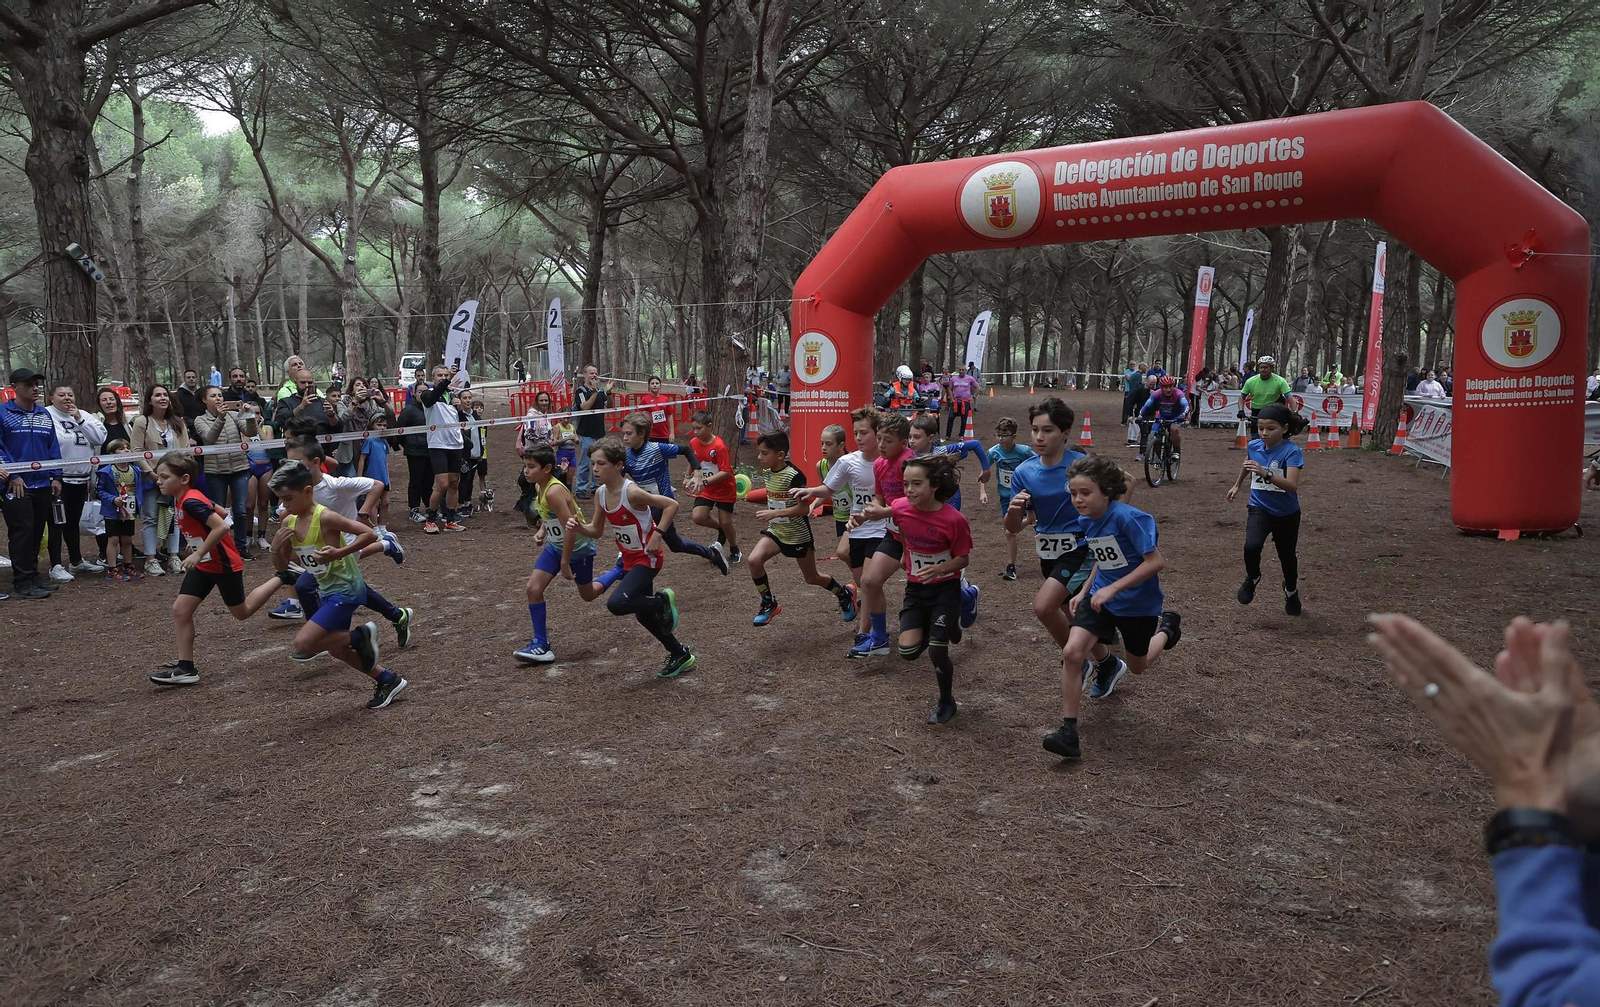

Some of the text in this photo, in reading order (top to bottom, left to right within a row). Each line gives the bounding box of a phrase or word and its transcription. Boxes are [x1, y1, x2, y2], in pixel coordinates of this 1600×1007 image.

[1054, 136, 1304, 185] Delegación de Deportes
[1054, 170, 1303, 211] Ilustre Ayuntamiento de San Roque
[452, 309, 470, 332] 2
[549, 308, 558, 328] 2
[1466, 374, 1575, 391] Delegación de Deportes
[811, 390, 819, 399] de
[820, 390, 849, 400] Deportes
[1484, 391, 1533, 401] Ayuntamiento
[1534, 389, 1543, 398] de
[1544, 388, 1557, 397] San
[1040, 538, 1073, 552] 275
